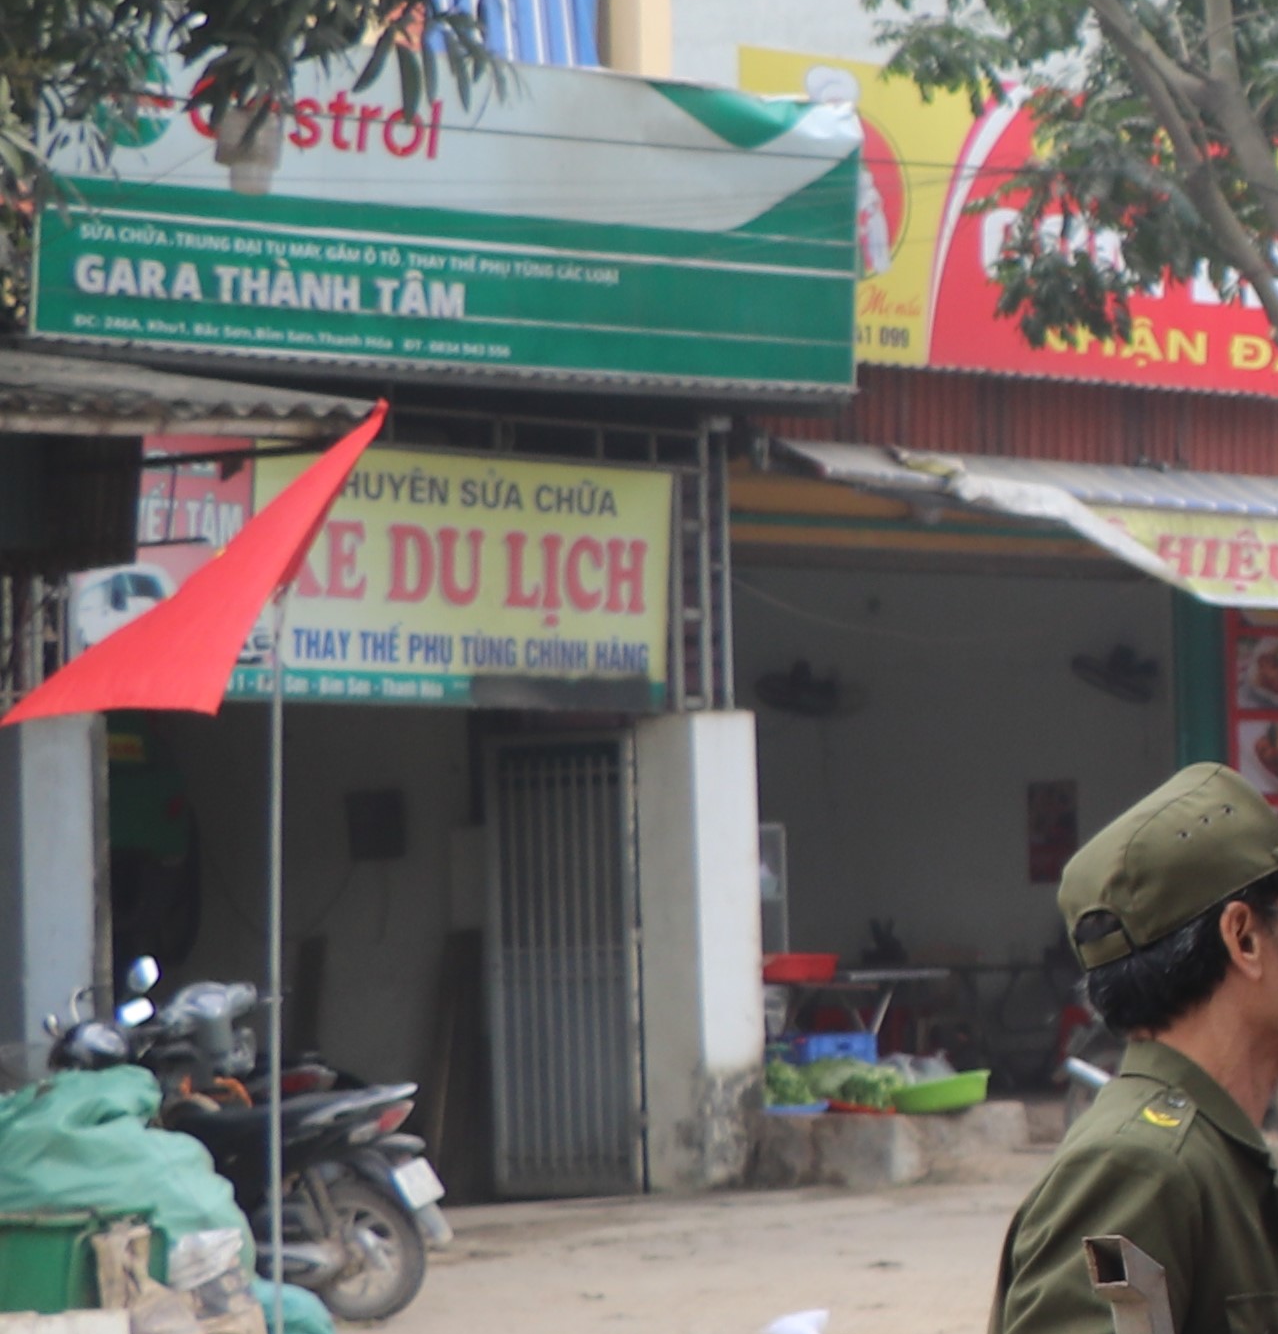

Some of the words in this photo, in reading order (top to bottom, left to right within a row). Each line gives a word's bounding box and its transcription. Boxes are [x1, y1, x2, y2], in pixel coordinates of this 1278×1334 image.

[186, 75, 442, 160] strol
[74, 254, 202, 301] GARA
[214, 256, 361, 313] THÀNH
[375, 270, 466, 318] TÂM
[340, 469, 449, 507] HUYÊN
[460, 467, 524, 511] SỬA
[535, 480, 619, 517] CHỮA
[386, 523, 485, 607] DU
[503, 529, 648, 628] LỊCH
[293, 626, 352, 661] THAY
[360, 620, 403, 663] THẾ
[408, 633, 454, 674] PHỤ
[462, 628, 517, 668] TÙNG
